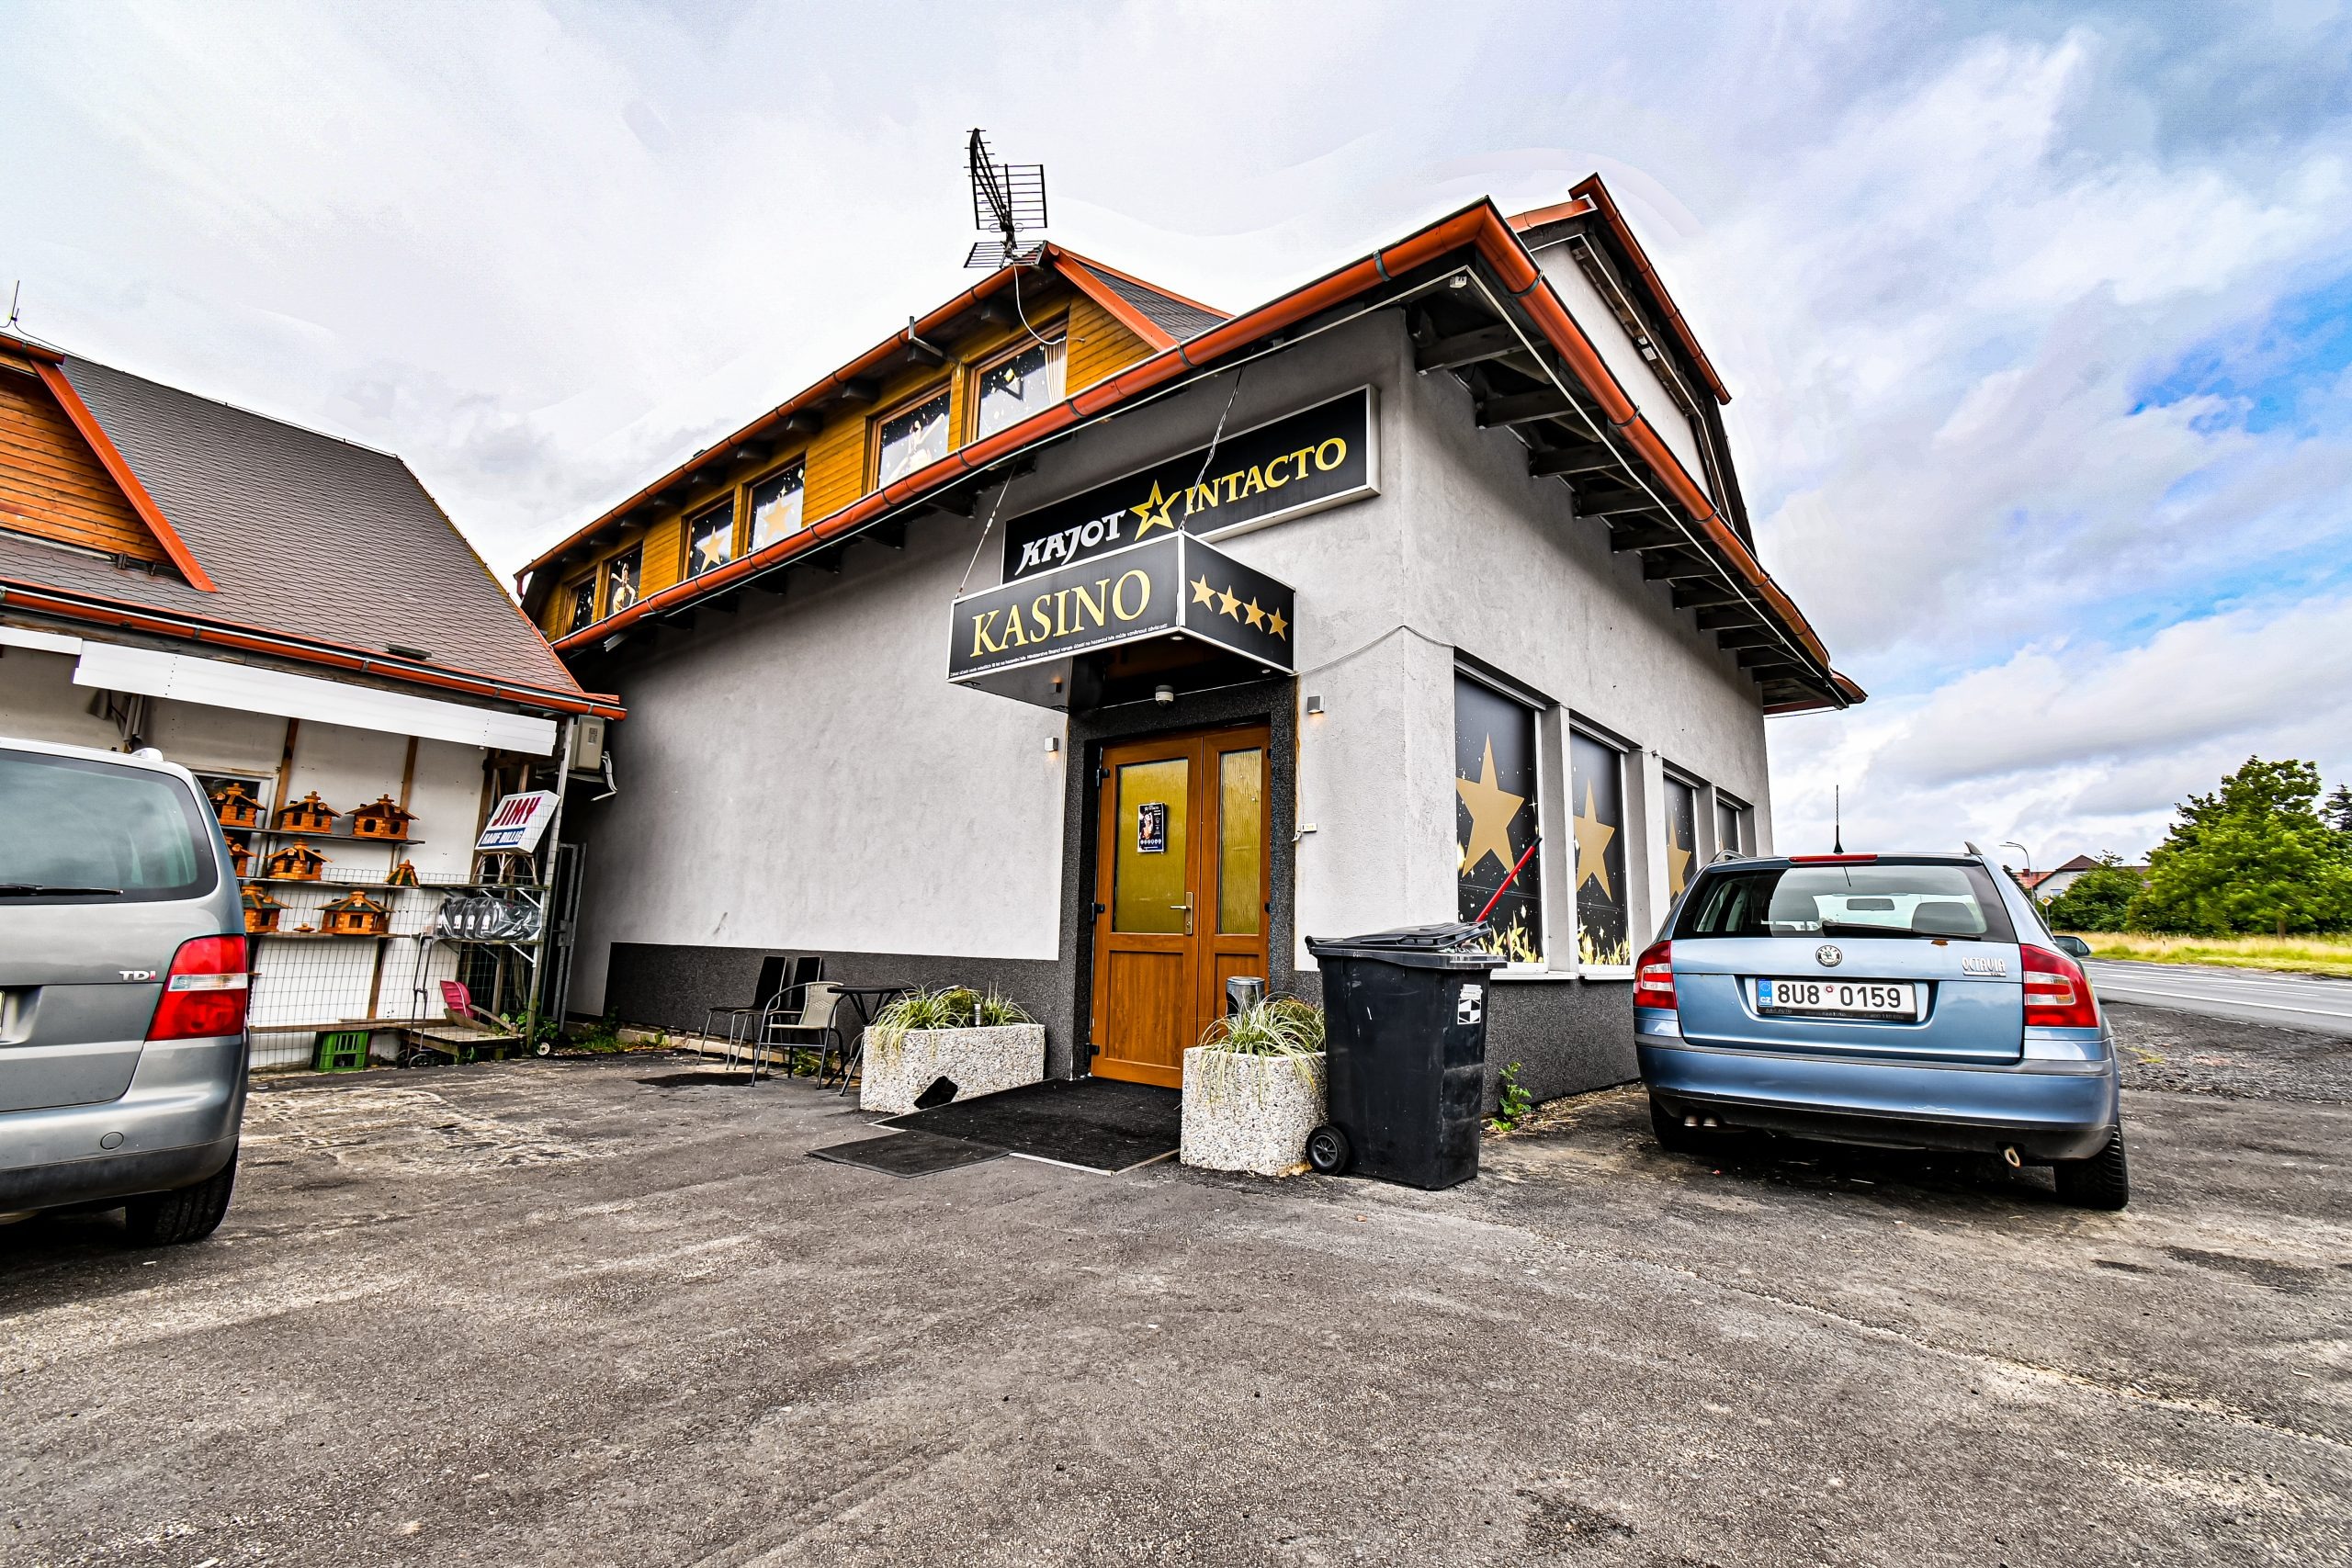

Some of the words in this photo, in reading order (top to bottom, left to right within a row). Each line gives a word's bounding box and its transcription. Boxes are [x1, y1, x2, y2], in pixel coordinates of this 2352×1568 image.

[1014, 509, 1125, 576] KAJOT
[1183, 437, 1348, 516] INTACTO
[969, 569, 1152, 658] KASINO
[491, 796, 542, 827] JIMY
[481, 832, 502, 845] KAUF
[499, 830, 523, 843] BILLIG
[119, 970, 156, 981] TDI
[1962, 956, 2006, 973] OCTAVIA
[1777, 984, 1820, 1005] 8U8
[1839, 986, 1901, 1009] 0159
